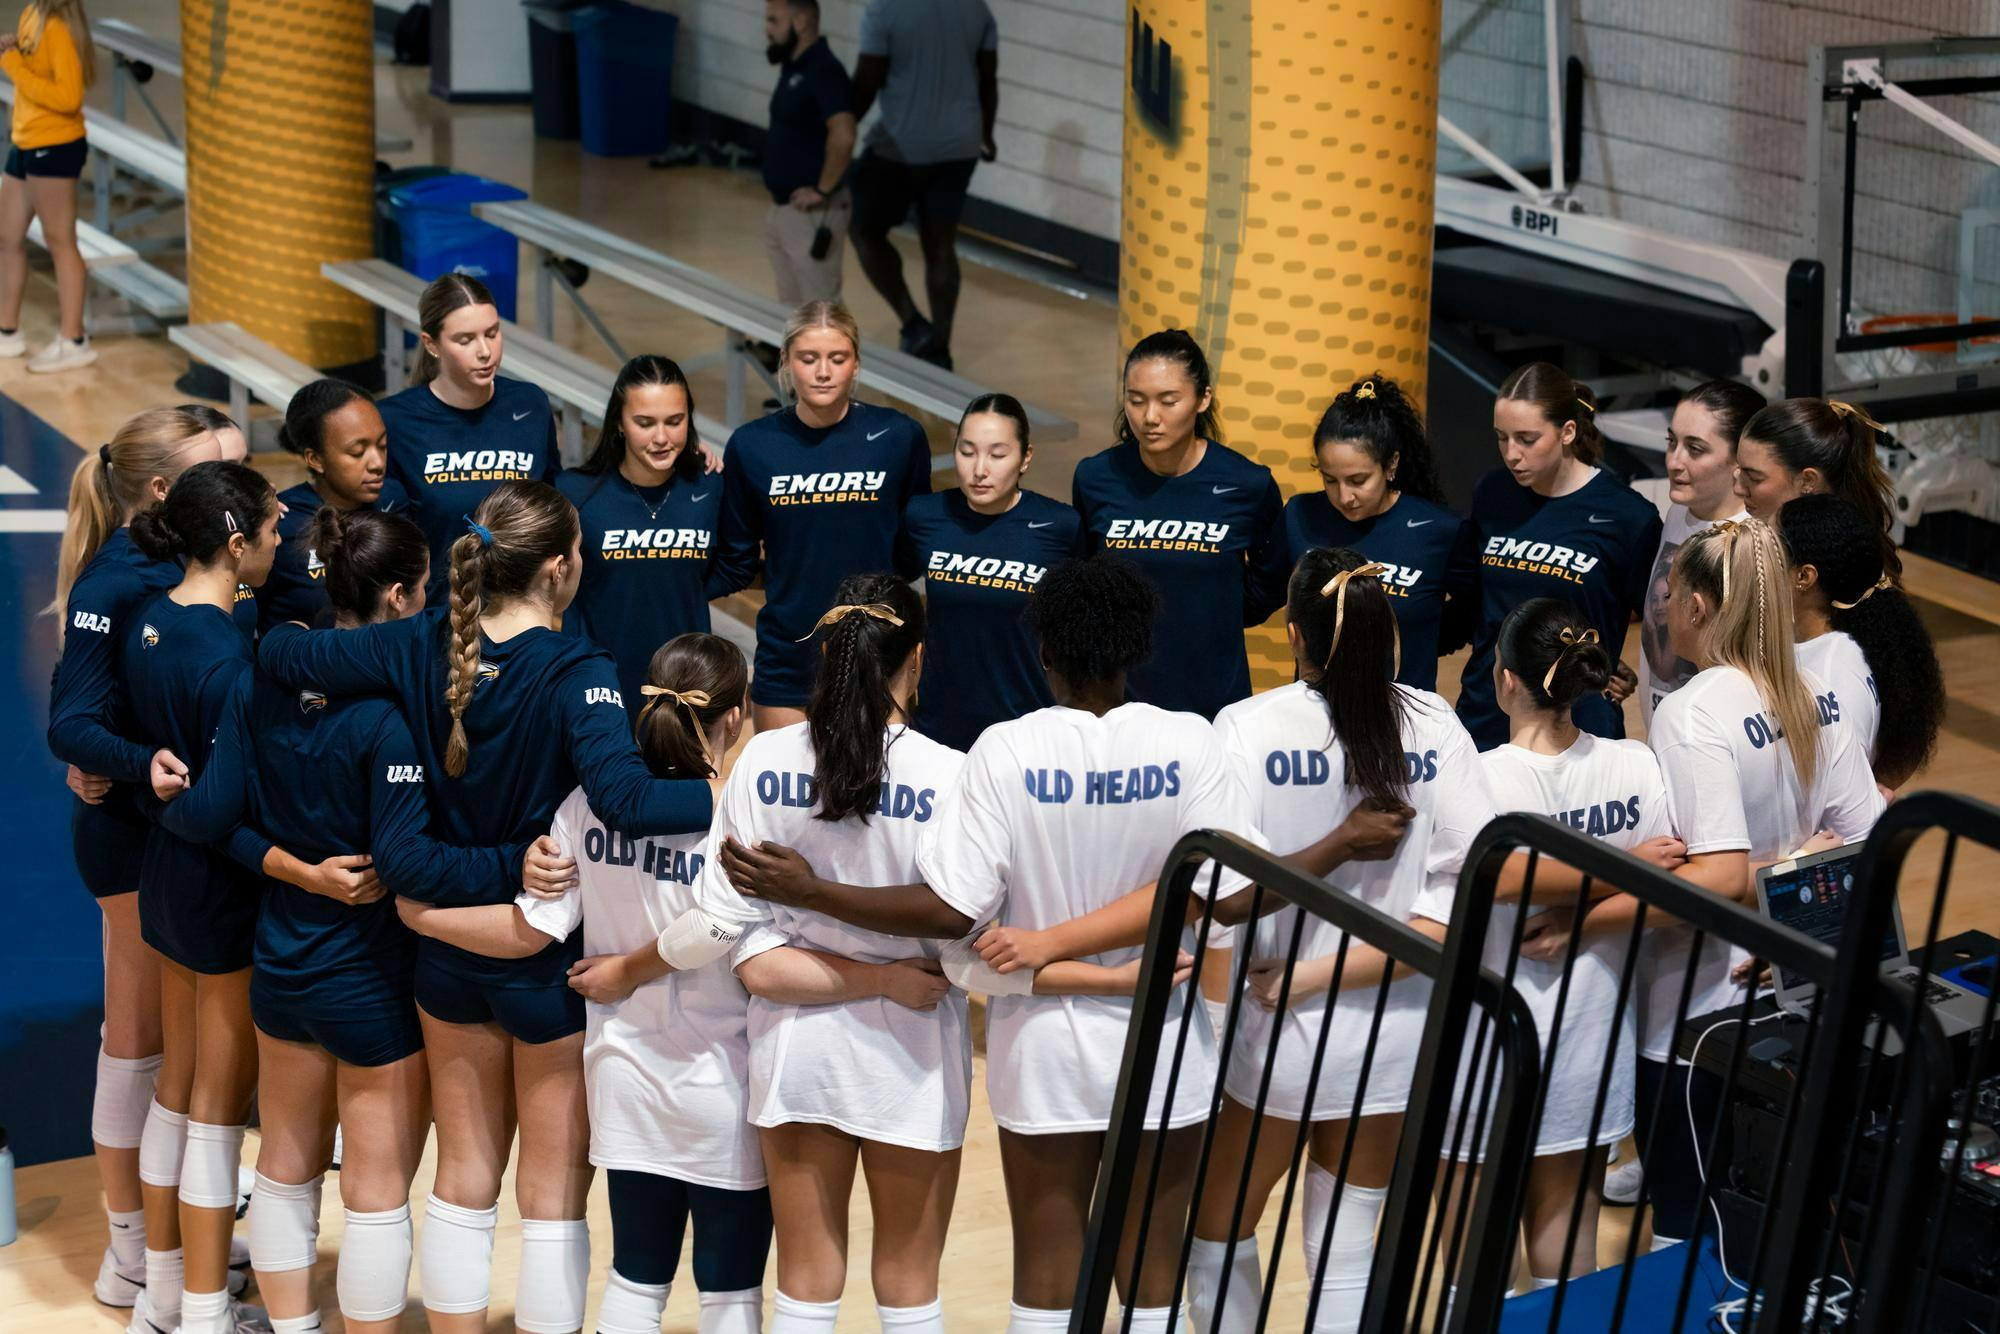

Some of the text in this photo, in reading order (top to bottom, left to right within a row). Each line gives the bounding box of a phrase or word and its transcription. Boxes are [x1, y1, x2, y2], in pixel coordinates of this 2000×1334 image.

[1526, 209, 1558, 236] BPI
[424, 450, 534, 474] EMORY
[424, 471, 529, 485] VOLLEYBALL
[769, 471, 887, 496] EMORY
[769, 491, 879, 506] VOLLEYBALL
[601, 529, 711, 550] EMORY
[1106, 519, 1230, 543] EMORY
[601, 548, 708, 560] VOLLEYBALL
[1105, 539, 1220, 553] VOLLEYBALL
[1484, 536, 1599, 574] EMORY
[928, 551, 1048, 584] EMORY
[1481, 555, 1584, 584] VOLLEYBALL
[74, 611, 111, 634] UAA
[585, 687, 625, 709] UAA
[387, 765, 425, 783] UAA
[1265, 750, 1329, 786] OLD
[757, 770, 818, 808] OLD
[1085, 760, 1180, 805] HEADS
[585, 827, 637, 866] OLD
